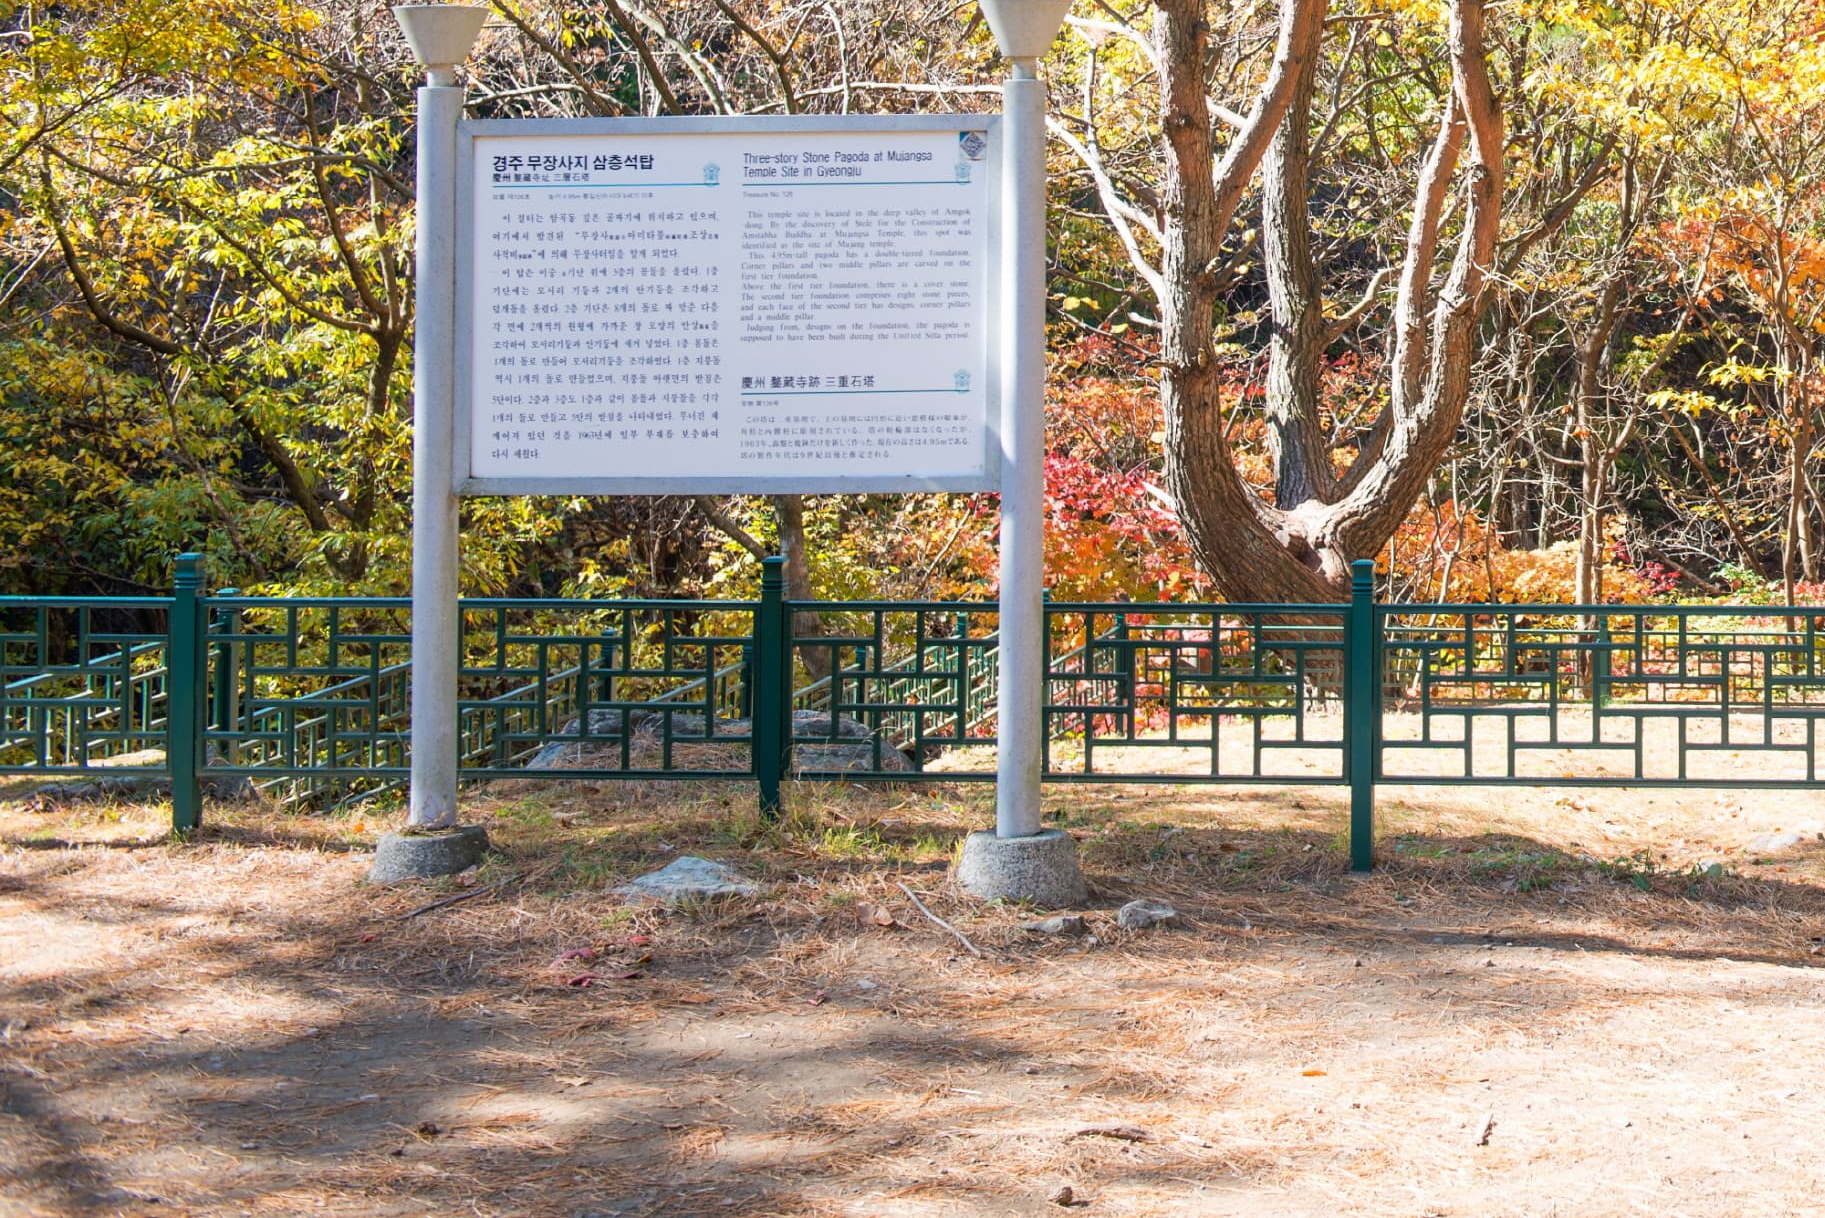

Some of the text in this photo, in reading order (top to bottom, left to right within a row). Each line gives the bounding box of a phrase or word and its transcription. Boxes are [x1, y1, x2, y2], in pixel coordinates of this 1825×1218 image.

[493, 154, 655, 172] 경주 무장사지 삼층석탑
[743, 150, 933, 164] Three-story Stone Pagoda at Mujangsa
[744, 165, 862, 178] Temple Site in Gyeongju
[741, 376, 765, 389] 慶州
[825, 374, 875, 388] 三重石塔
